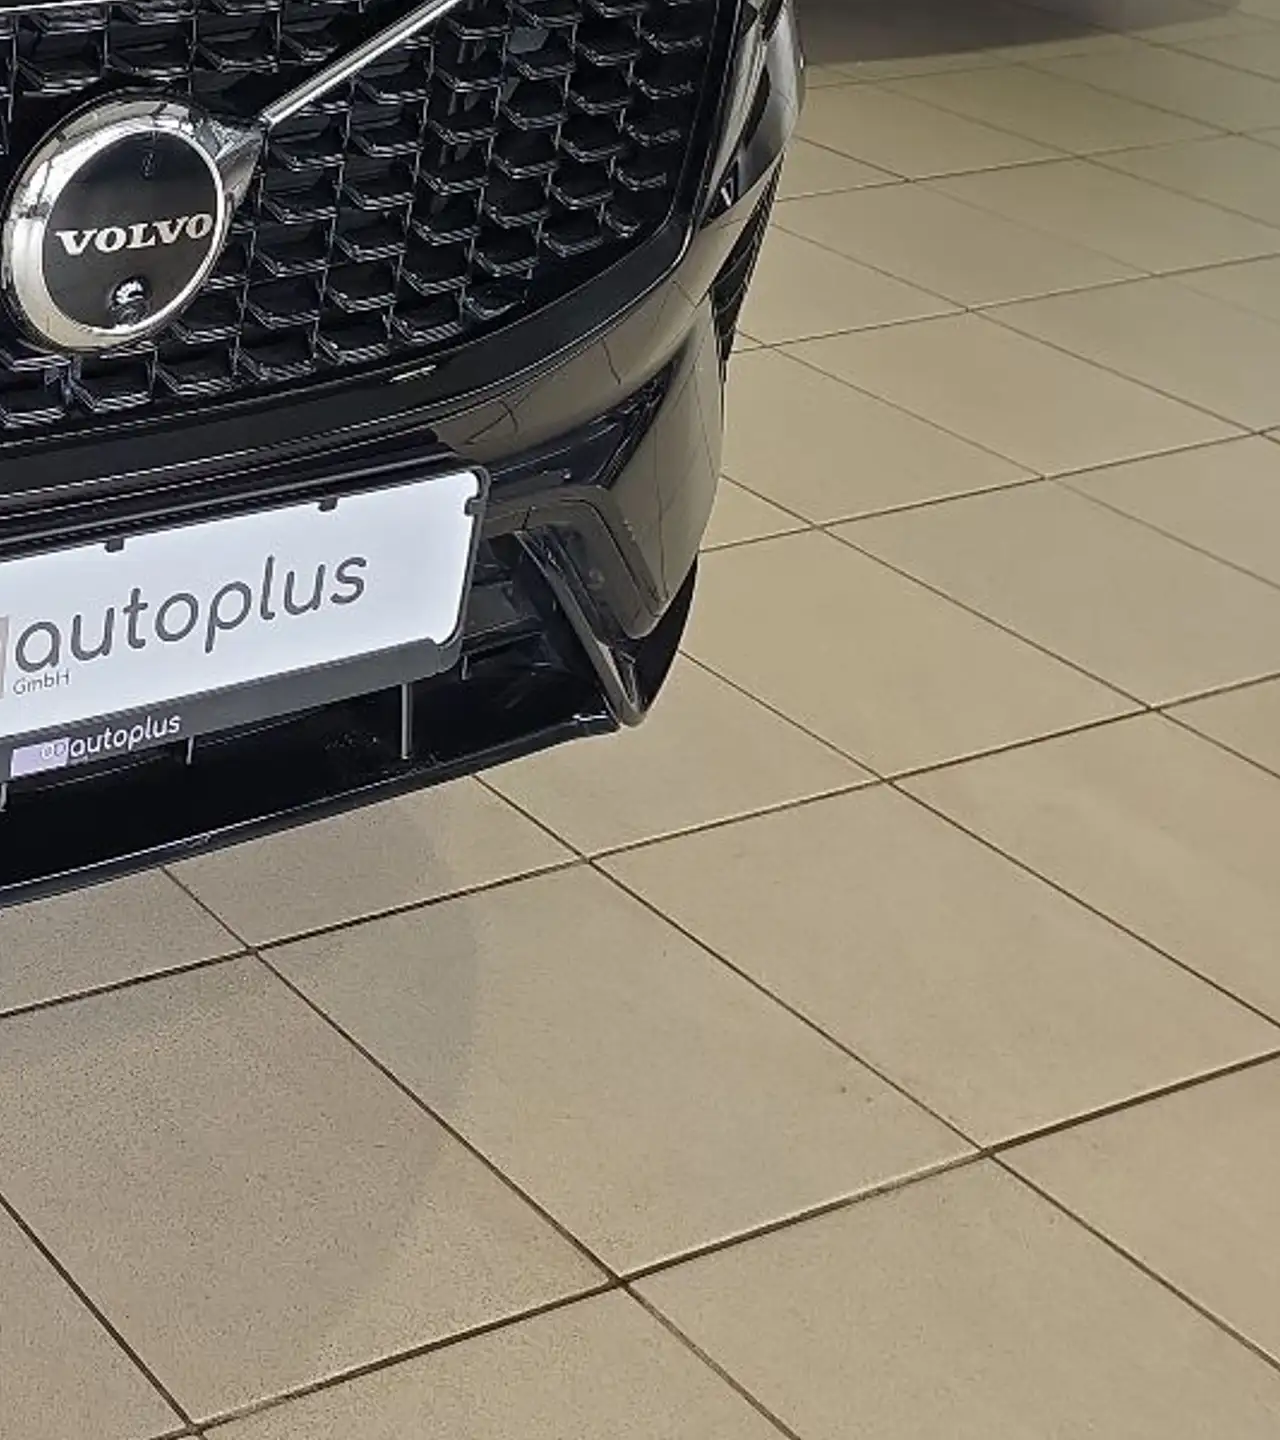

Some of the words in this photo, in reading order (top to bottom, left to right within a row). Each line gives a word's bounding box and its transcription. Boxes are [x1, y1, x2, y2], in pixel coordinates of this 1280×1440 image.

[56, 212, 213, 256] VOLVO
[14, 555, 369, 674] autoplus
[12, 671, 71, 696] GmbH
[69, 714, 182, 758] autoplus
